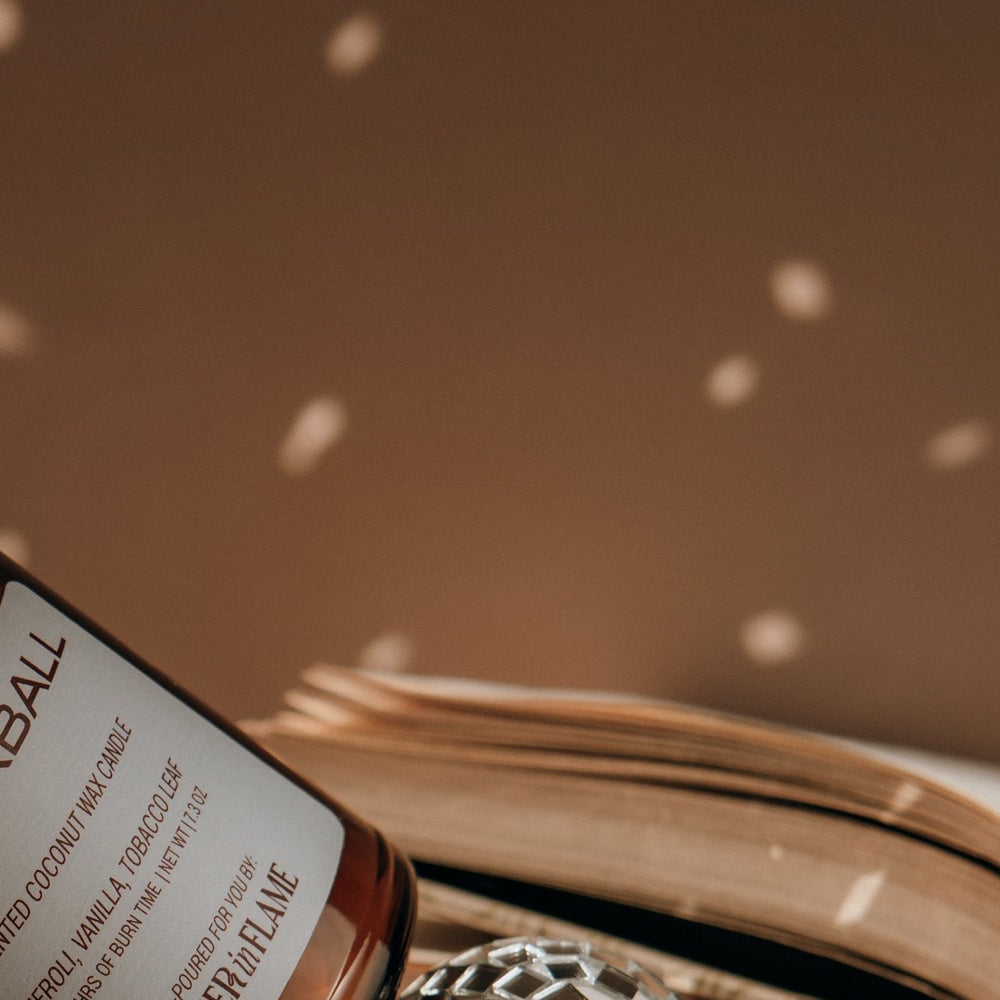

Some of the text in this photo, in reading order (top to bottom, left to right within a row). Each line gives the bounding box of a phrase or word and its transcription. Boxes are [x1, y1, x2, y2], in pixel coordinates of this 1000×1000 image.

[24, 809, 84, 901] COCONUT
[75, 772, 107, 816] WAX
[96, 716, 131, 779] CANDLE
[70, 876, 131, 950] VANILLA,
[117, 793, 168, 875] TOBACCO
[157, 756, 182, 799] LEAF
[95, 953, 114, 976] OF
[108, 913, 142, 957] BURN
[133, 880, 162, 915] TIME
[157, 845, 179, 875] NET
[170, 825, 189, 848] WT
[182, 802, 200, 823] 7.3
[191, 785, 207, 805] OZ
[208, 905, 233, 940] FOR
[224, 874, 247, 908] YOU
[238, 855, 257, 880] BY:
[237, 862, 299, 954] FLAME
